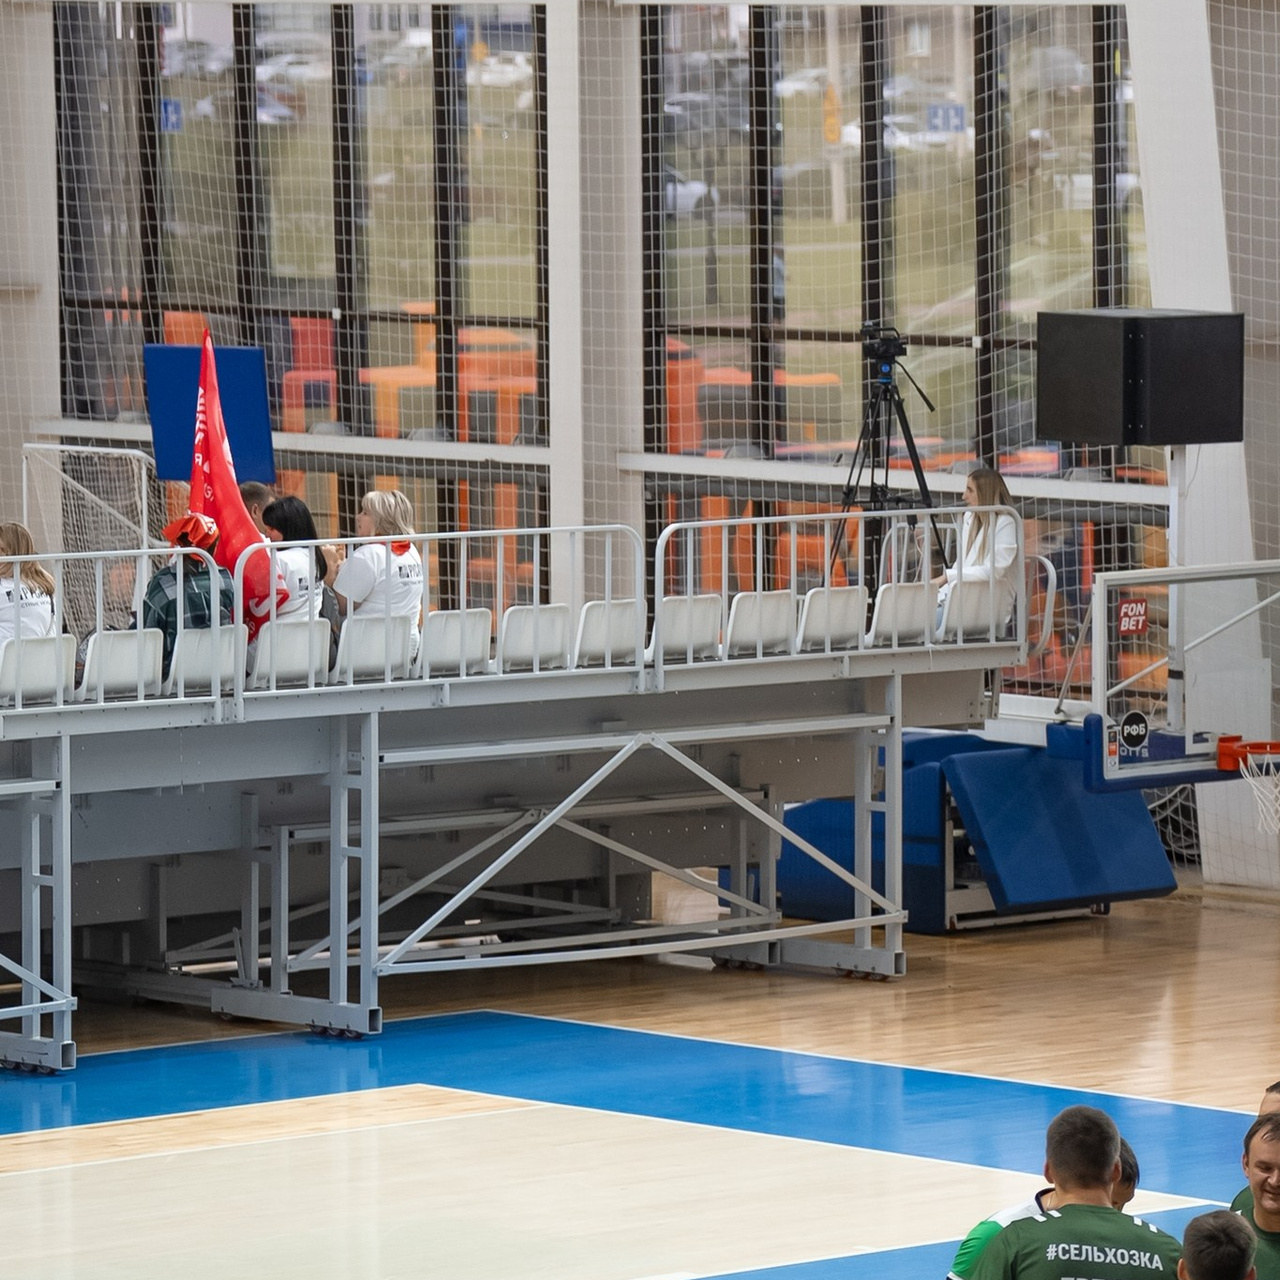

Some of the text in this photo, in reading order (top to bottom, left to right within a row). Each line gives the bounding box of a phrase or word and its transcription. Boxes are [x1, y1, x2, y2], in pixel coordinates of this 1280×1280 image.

[1120, 602, 1145, 617] FON
[1120, 616, 1145, 631] BET
[1123, 723, 1146, 737] РФБ
[1046, 1243, 1164, 1272] #СЕЛЬХОЗКА
